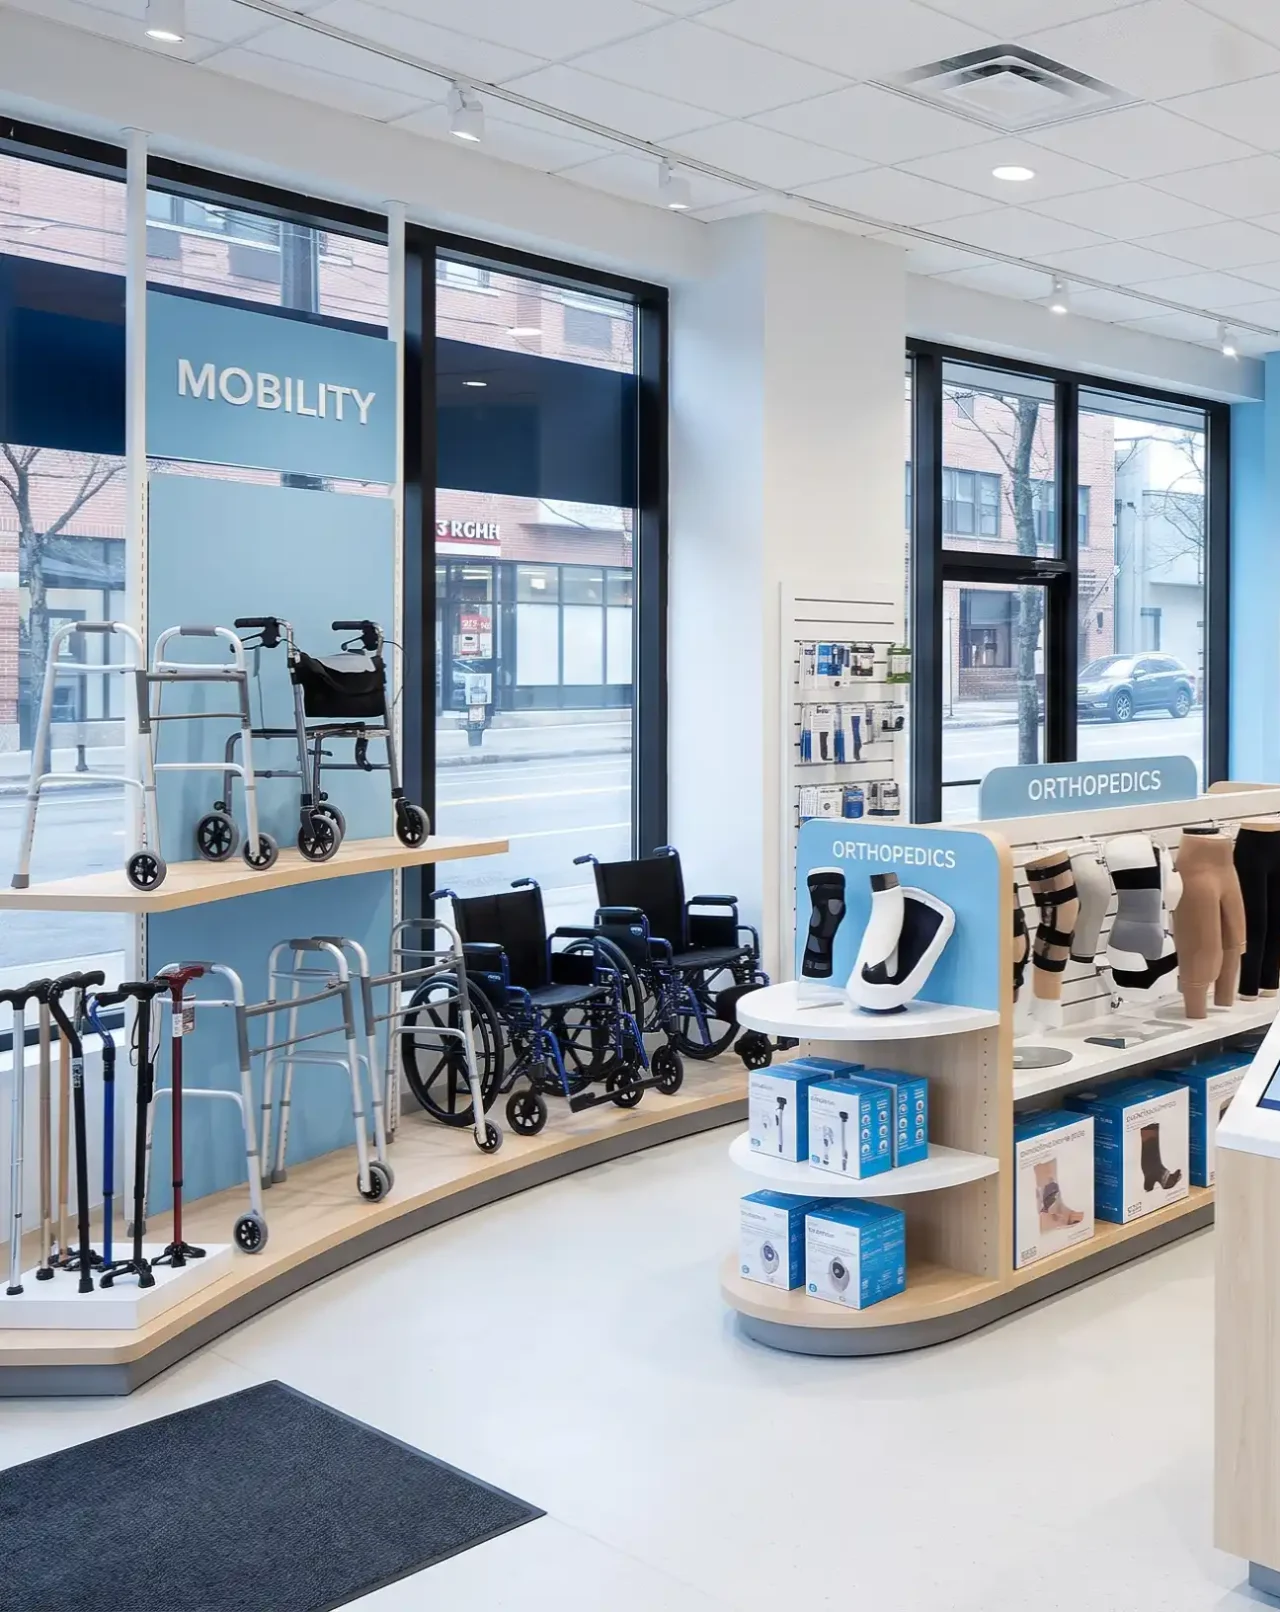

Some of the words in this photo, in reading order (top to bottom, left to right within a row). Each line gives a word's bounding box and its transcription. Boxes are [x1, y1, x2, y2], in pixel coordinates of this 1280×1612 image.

[178, 358, 376, 425] MOBILITY
[1028, 770, 1161, 801] ORTHOPEDICS
[832, 840, 956, 869] ORTHOPEDICS
